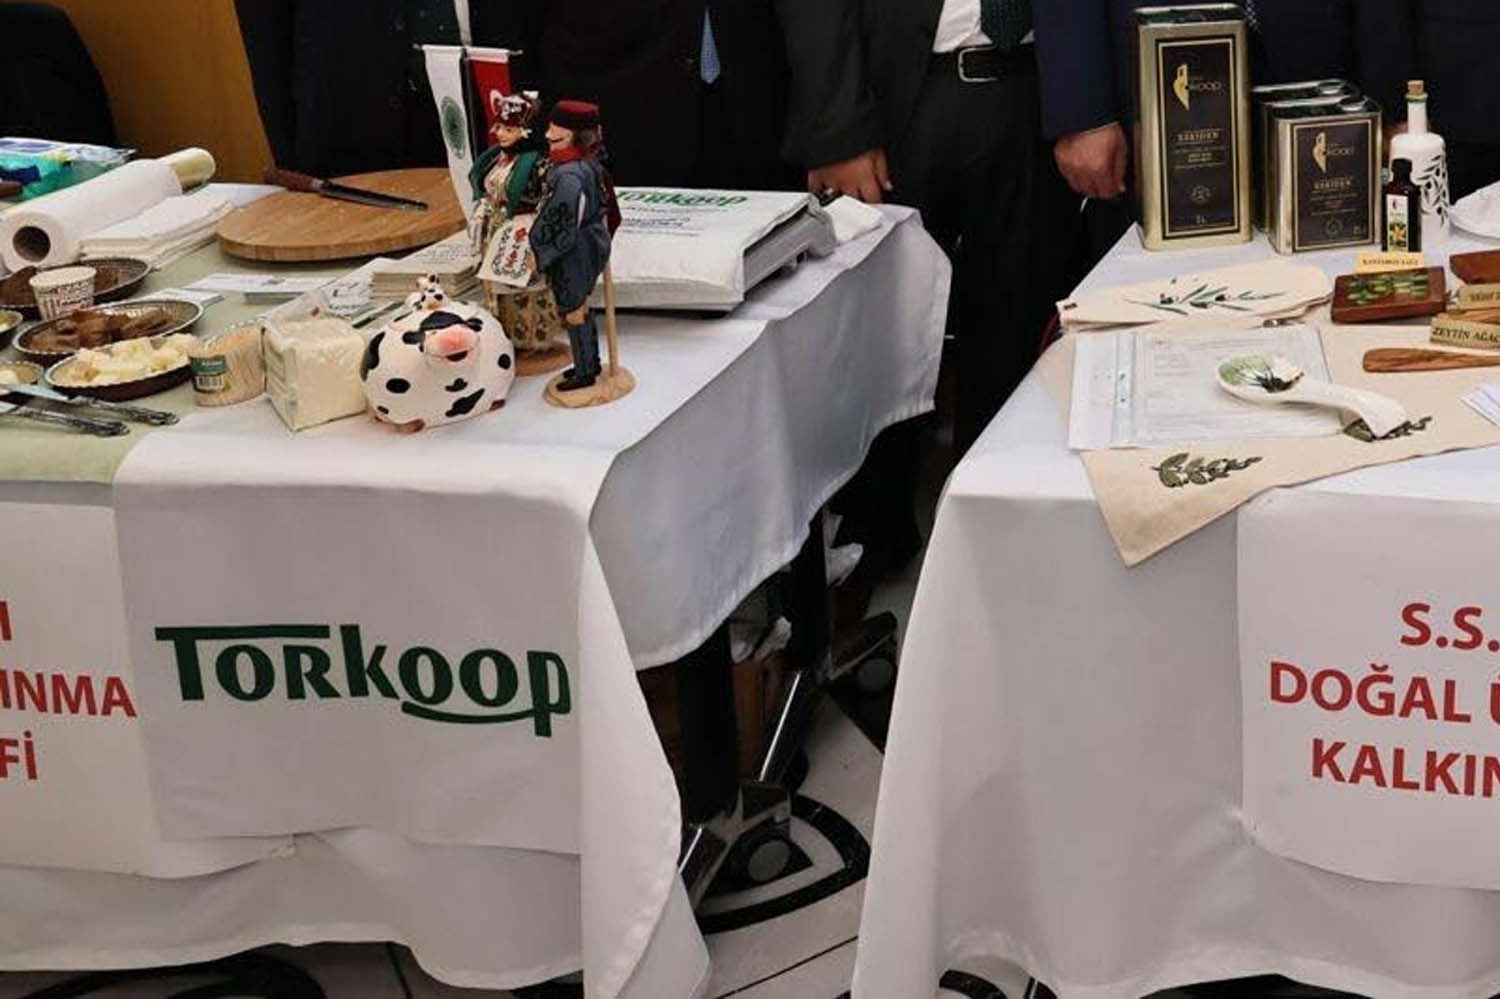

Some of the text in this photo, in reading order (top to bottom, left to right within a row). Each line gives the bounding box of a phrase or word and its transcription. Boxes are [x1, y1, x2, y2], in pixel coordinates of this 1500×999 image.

[1431, 325, 1471, 340] ZEYTİN
[1400, 602, 1500, 652] S.S.
[1269, 660, 1472, 724] DOĞAL
